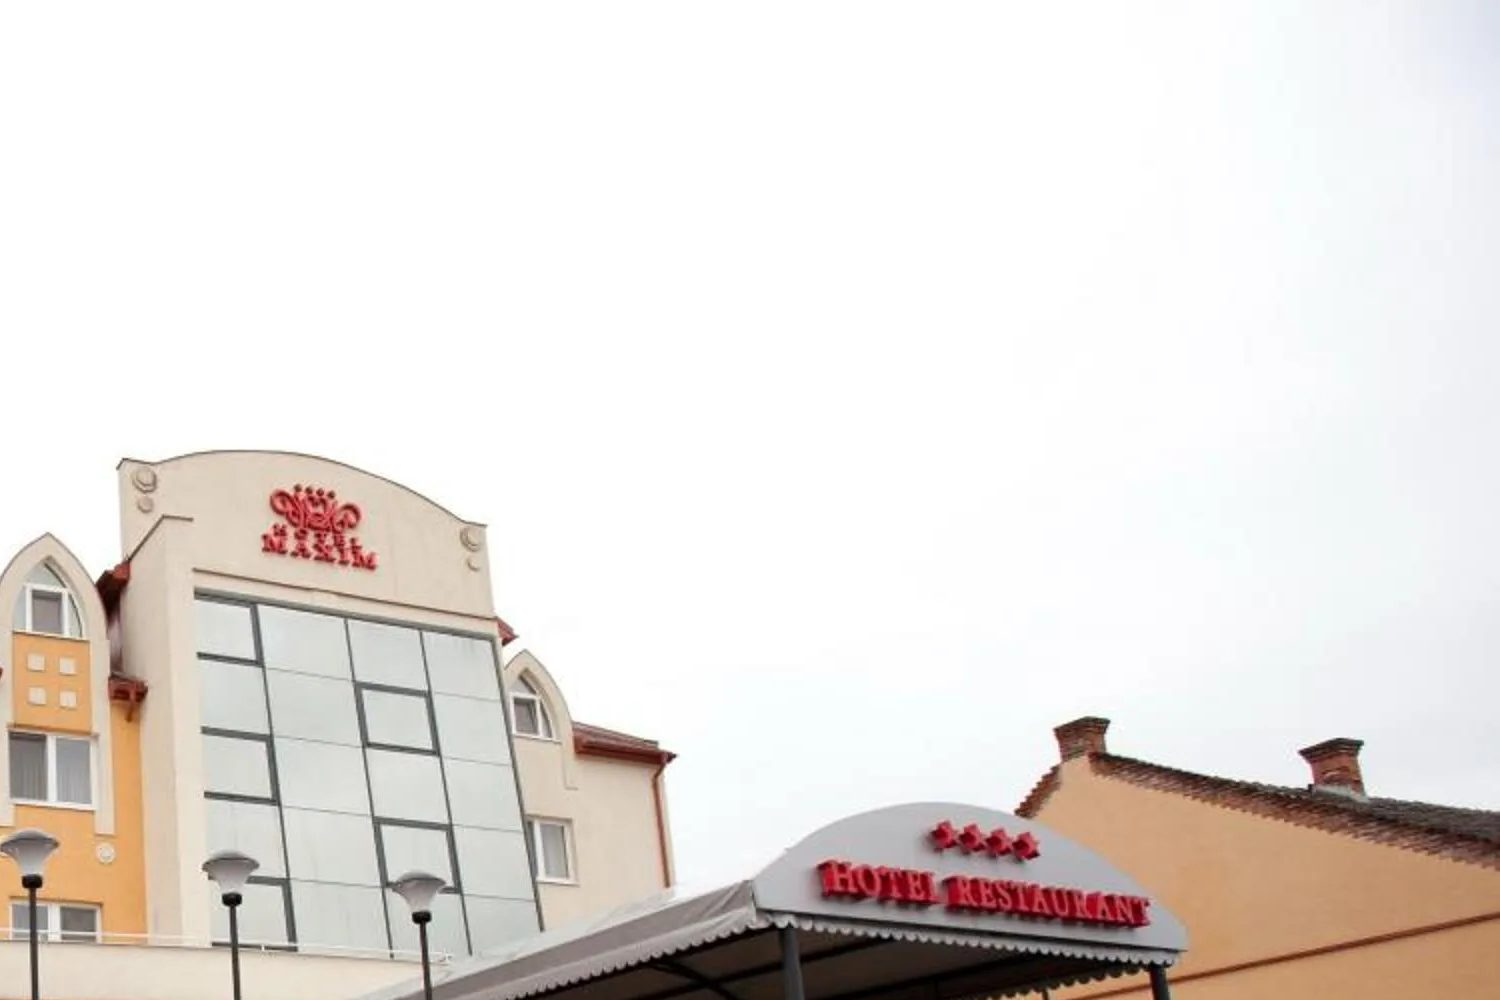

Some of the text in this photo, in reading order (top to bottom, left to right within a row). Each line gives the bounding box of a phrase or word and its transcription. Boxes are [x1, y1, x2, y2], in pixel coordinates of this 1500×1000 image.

[261, 533, 377, 570] MAXIM
[818, 860, 1151, 927] HOTEL RESTAURANT
